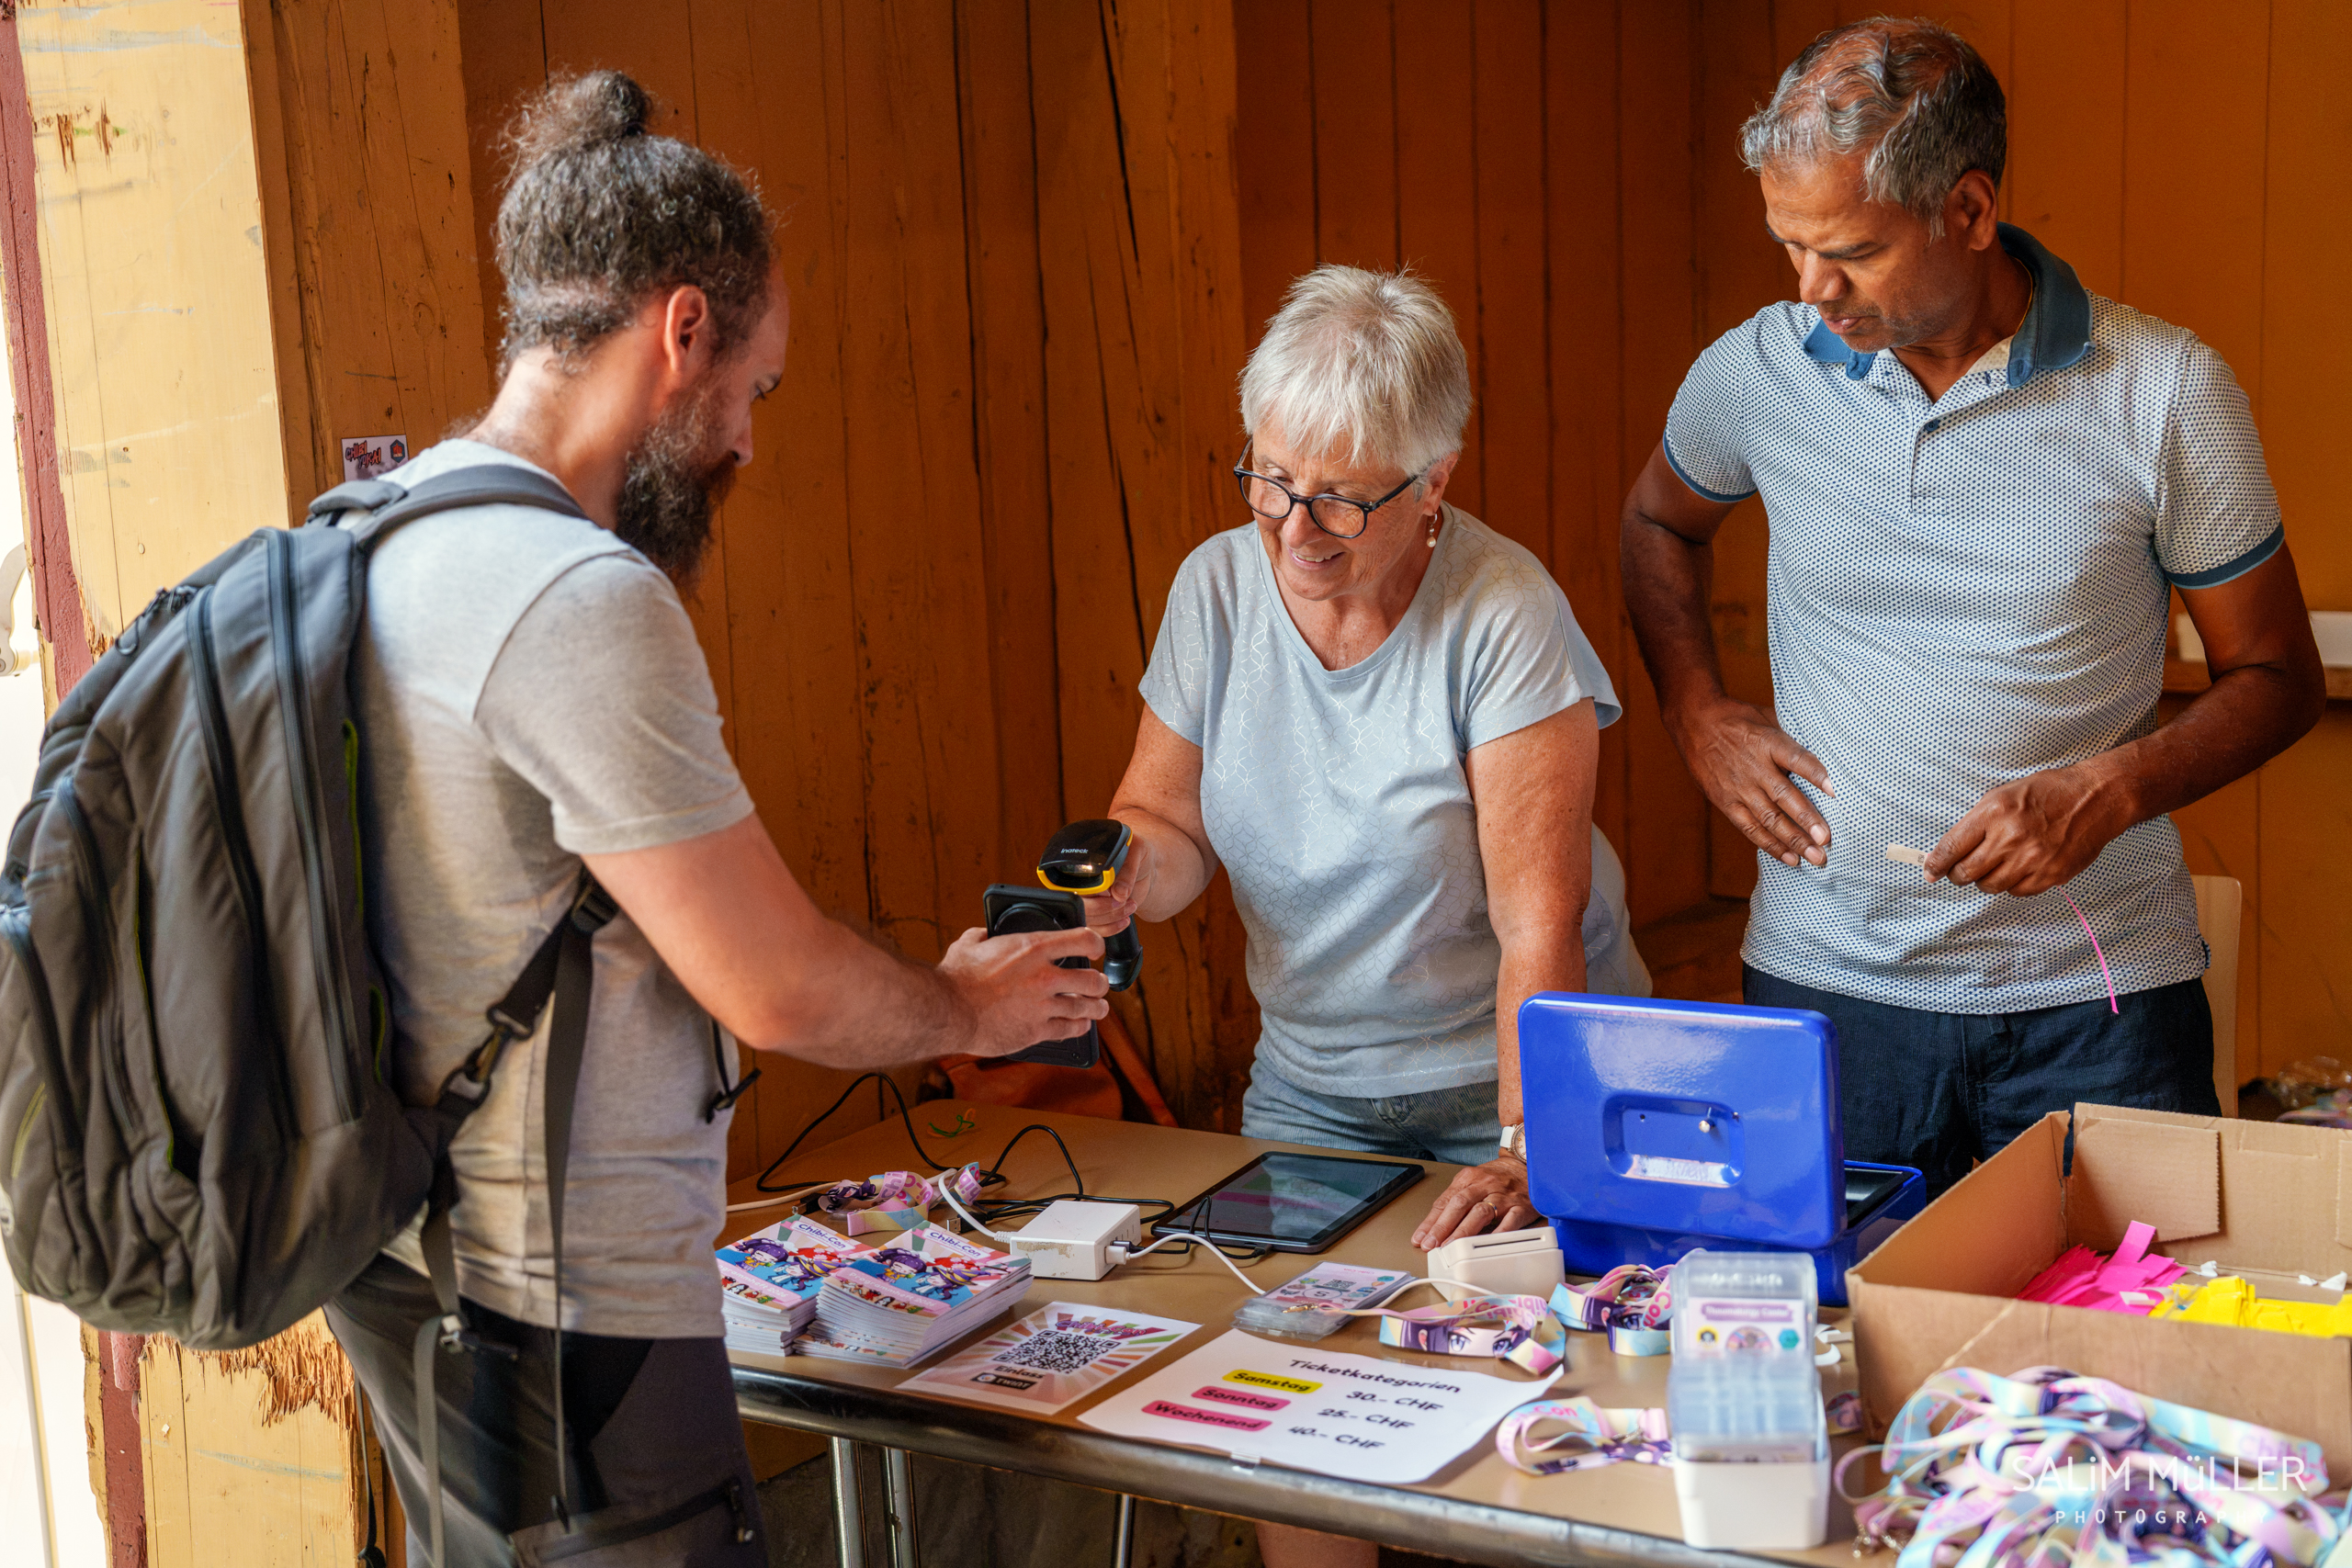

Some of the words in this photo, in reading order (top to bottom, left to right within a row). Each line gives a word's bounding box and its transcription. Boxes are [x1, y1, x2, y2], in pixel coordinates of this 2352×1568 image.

[345, 440, 368, 462] CHIBI
[798, 1223, 847, 1248] Chibi-Con
[930, 1231, 981, 1258] Chibi-Con
[994, 1365, 1046, 1379] Einlass
[1289, 1359, 1462, 1393] Ticketkategorien
[1234, 1372, 1311, 1393] Samstag
[1346, 1391, 1388, 1403] 30.-
[1395, 1397, 1444, 1411] CHF
[1202, 1389, 1279, 1409] Sonntag
[1364, 1414, 1416, 1428] CHF
[1154, 1403, 1262, 1429] Wochenend
[1334, 1433, 1385, 1449] CHF
